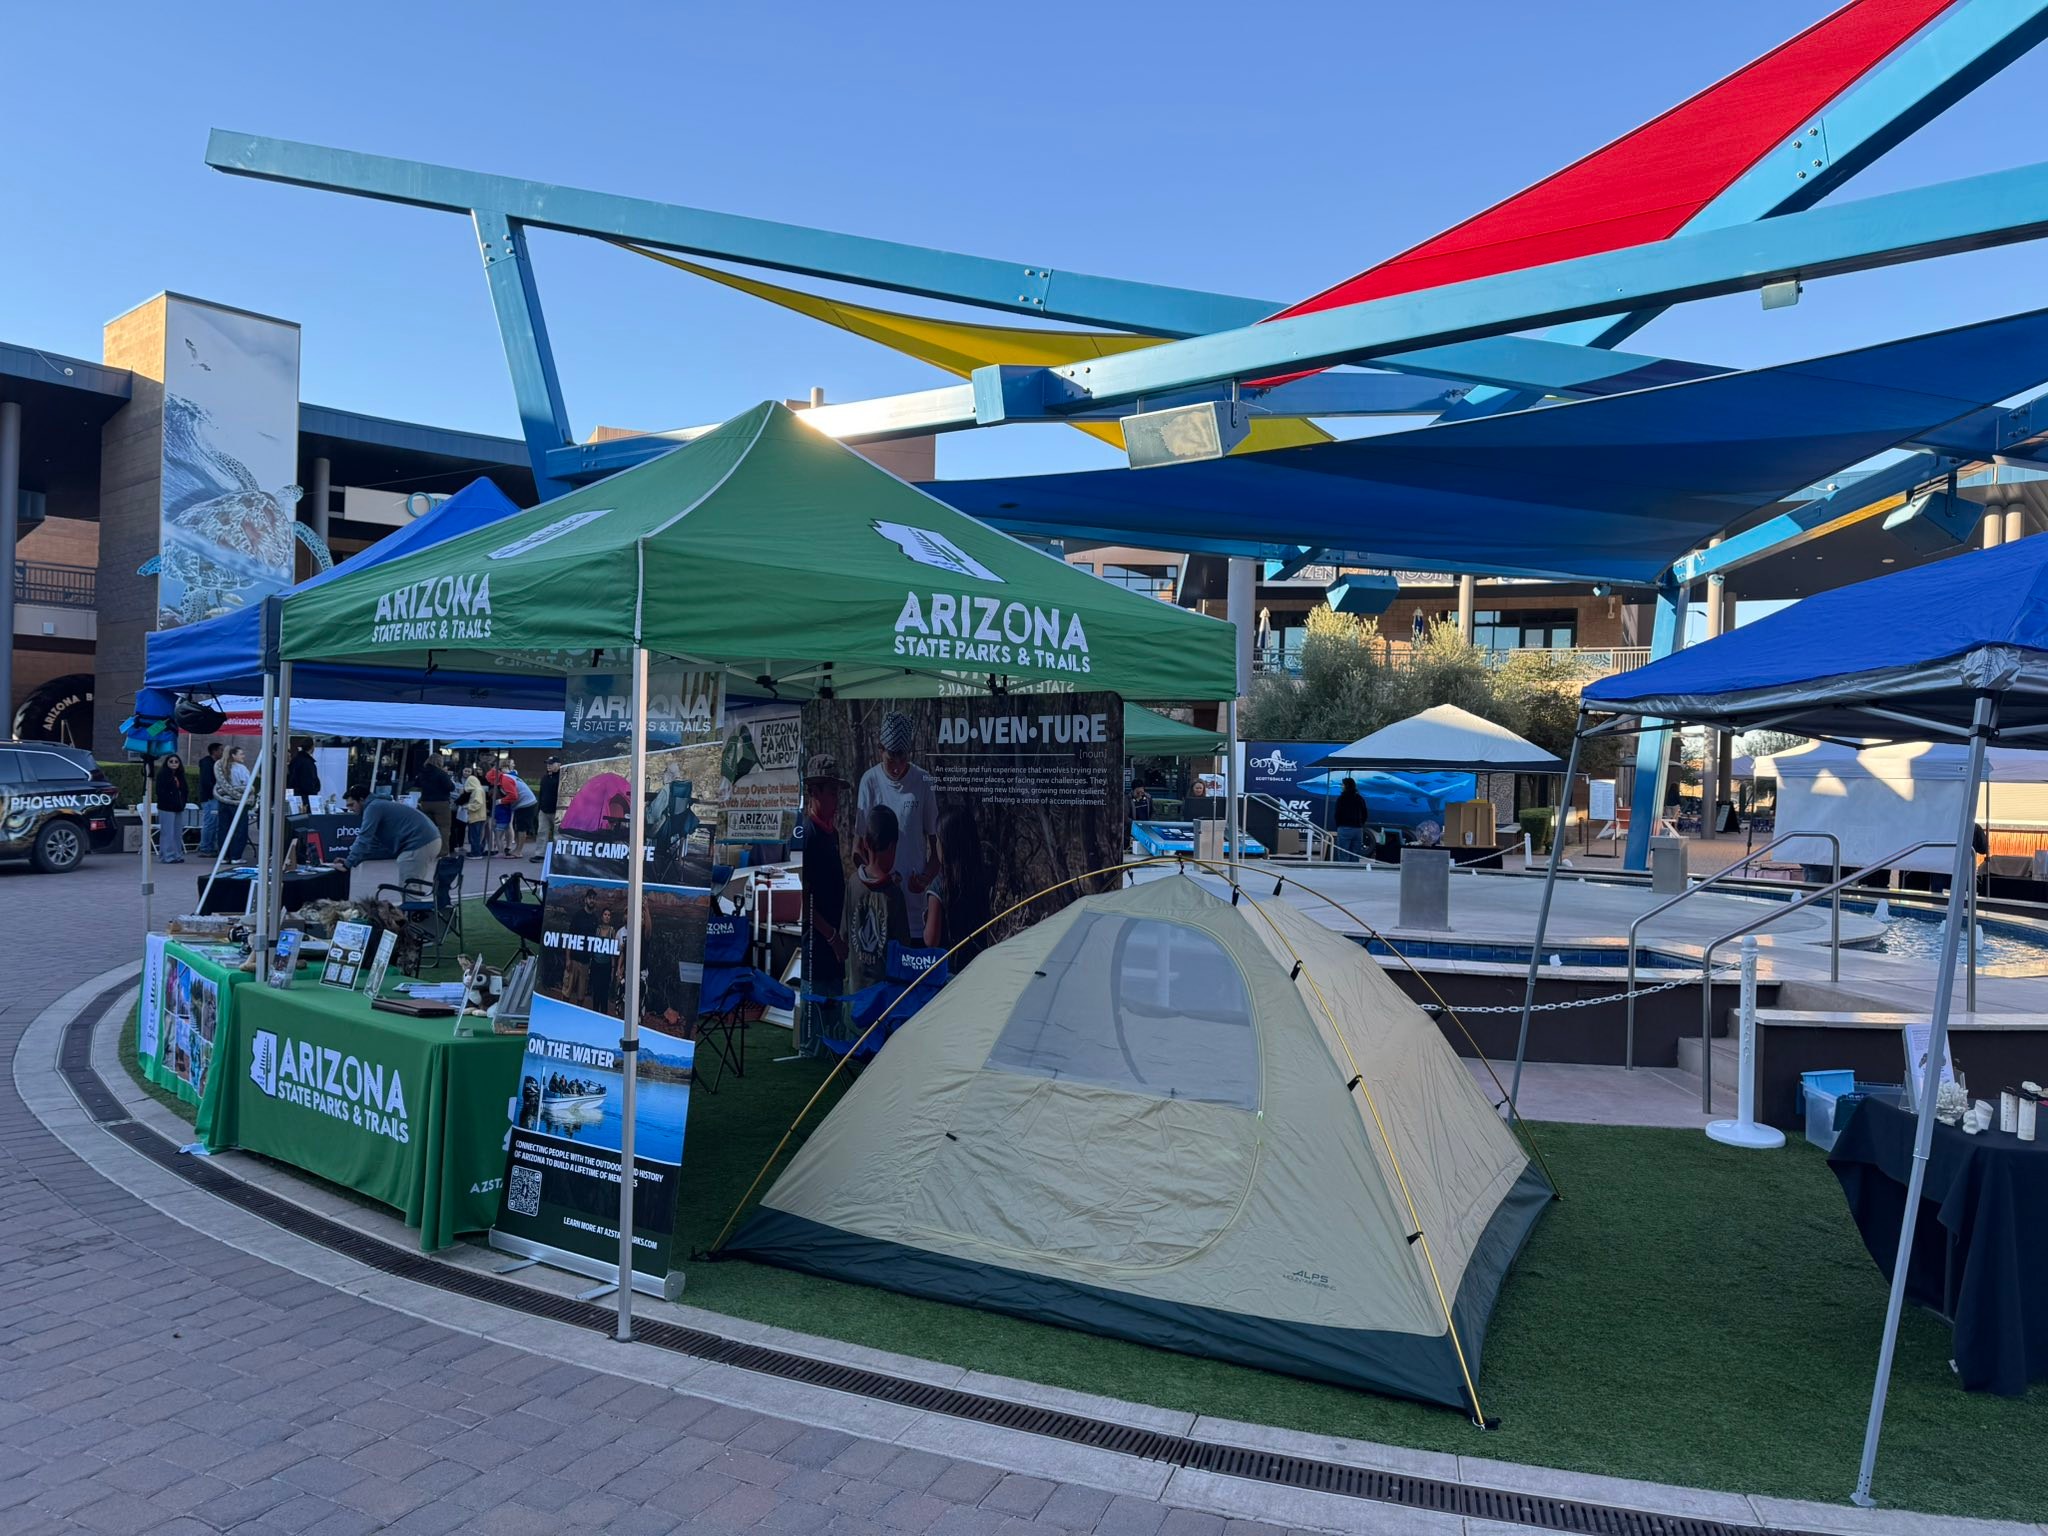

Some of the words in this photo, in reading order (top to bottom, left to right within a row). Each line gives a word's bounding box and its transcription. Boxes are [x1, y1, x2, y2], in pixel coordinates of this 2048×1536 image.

[374, 573, 491, 622] ARIZONA
[372, 623, 403, 642] STATE
[402, 620, 436, 640] PARKS
[440, 620, 448, 640] &
[452, 619, 491, 639] TRAILS
[895, 591, 1089, 652] ARIZONA
[894, 635, 950, 658] STATE
[955, 641, 1011, 664] PARKS
[1017, 647, 1030, 666] &
[1035, 650, 1091, 672] TRAILS
[43, 694, 81, 731] ARIZONA
[586, 694, 711, 719] ARIONA
[584, 721, 615, 732] STATE
[659, 721, 670, 732] &
[670, 721, 711, 732] TRAILS
[760, 722, 799, 737] ARIZONA
[760, 735, 799, 753] FAMILY
[760, 751, 798, 765] CAMPOUT
[1079, 749, 1108, 759] [noun]
[945, 766, 968, 774] exciting
[993, 767, 1026, 775] experience
[1043, 766, 1070, 774] involves
[1070, 767, 1091, 775] trying
[943, 776, 970, 784] exploring
[985, 776, 1006, 784] places,
[1015, 776, 1035, 785] facing
[1051, 776, 1088, 786] challenges.
[1090, 776, 1108, 786] They
[969, 785, 993, 794] learning
[1009, 786, 1030, 795] things,
[1031, 787, 1058, 796] growing
[1078, 787, 1107, 796] resilient,
[11, 795, 78, 810] PHOENIX
[80, 793, 112, 806] ZOO
[994, 796, 1015, 805] having
[1049, 797, 1107, 807] accomplishment.
[739, 813, 778, 825] ARIZONA
[555, 840, 568, 855] AT
[570, 841, 593, 857] THE
[543, 931, 559, 948] ON
[561, 933, 585, 951] THE
[587, 936, 620, 956] TRAIL
[528, 1037, 545, 1055] ON
[547, 1041, 570, 1060] THE
[572, 1045, 615, 1068] WATER
[279, 1037, 407, 1118] ARIZONA
[278, 1080, 312, 1107] STATE
[312, 1091, 349, 1121] PARKS
[352, 1104, 361, 1126] &
[364, 1108, 409, 1143] TRAILS
[514, 1150, 522, 1159] OF
[522, 1152, 546, 1165] ARIZONA
[546, 1157, 553, 1166] TO
[553, 1159, 570, 1171] BUILD
[570, 1164, 574, 1172] A
[574, 1165, 600, 1178] LIFETIME
[600, 1171, 607, 1180] OF
[515, 1139, 549, 1155] CONNECTING
[549, 1148, 570, 1160] PEOPLE
[570, 1152, 584, 1163] WITH
[584, 1155, 595, 1166] THE
[638, 1169, 664, 1183] HISTORY
[563, 1216, 581, 1229] LEARN
[581, 1221, 597, 1233] MORE
[597, 1225, 604, 1234] AT
[1292, 1270, 1329, 1284] ALPS
